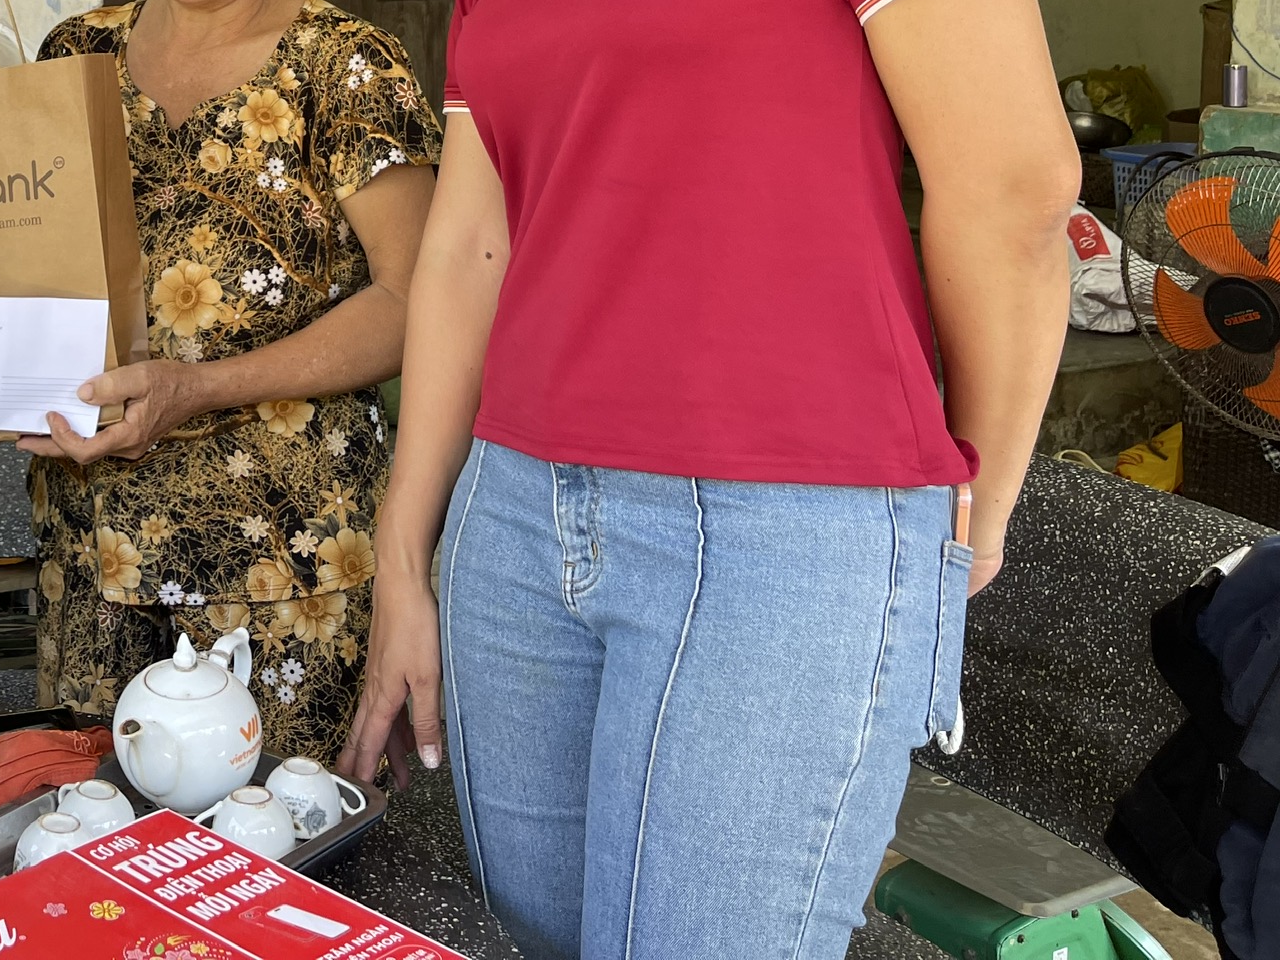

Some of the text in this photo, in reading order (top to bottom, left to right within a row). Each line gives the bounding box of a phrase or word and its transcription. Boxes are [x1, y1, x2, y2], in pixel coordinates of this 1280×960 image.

[89, 835, 142, 861] CƠ HỘI
[112, 831, 224, 884] TRÚNG
[153, 851, 252, 902] ĐIỆN THOẠI
[186, 867, 287, 921] MỖI NGÀY
[351, 924, 389, 945] NGÀN
[365, 931, 404, 954] THOẠI
